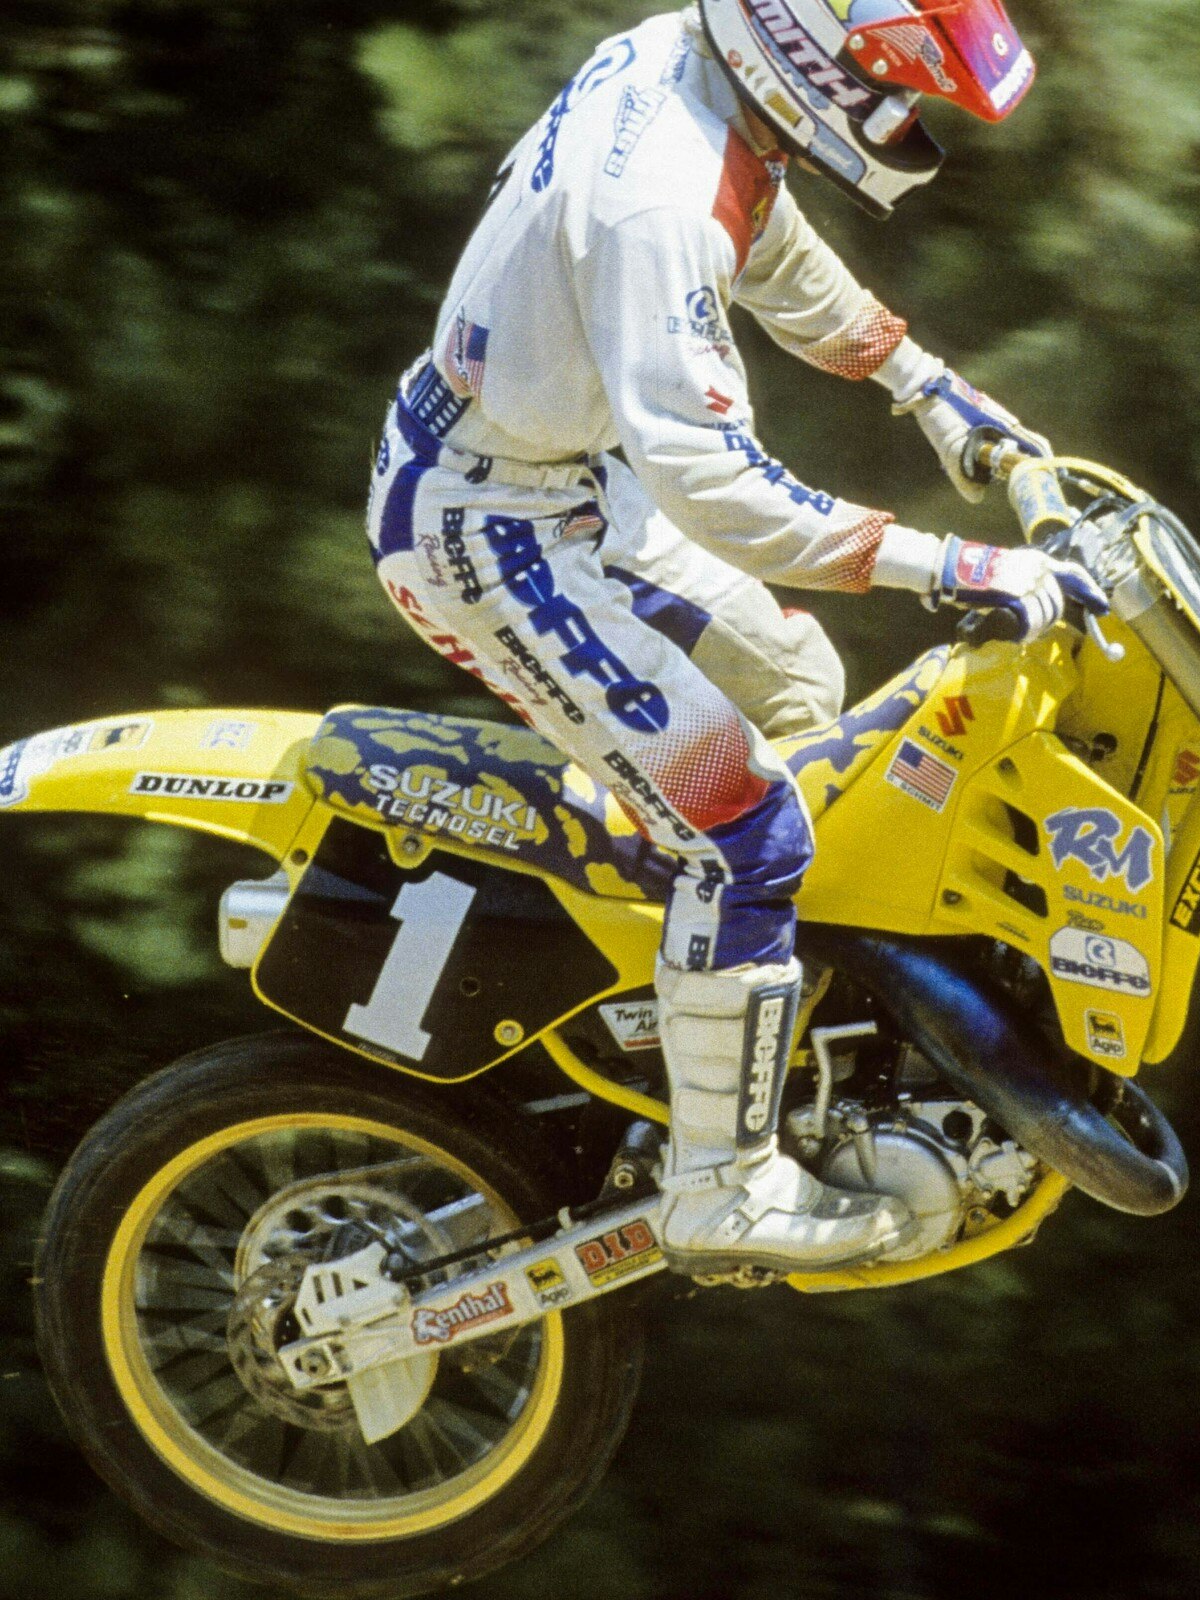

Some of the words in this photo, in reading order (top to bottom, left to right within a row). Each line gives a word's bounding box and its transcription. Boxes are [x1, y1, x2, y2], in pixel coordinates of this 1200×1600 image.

[136, 775, 287, 800] DUNLOP
[368, 764, 538, 832] SUZUKI
[374, 794, 521, 852] TECNOSEL
[1043, 806, 1156, 896] RM
[1062, 884, 1148, 920] SUZUKI
[342, 870, 477, 1061] 1
[615, 1008, 653, 1022] Twin
